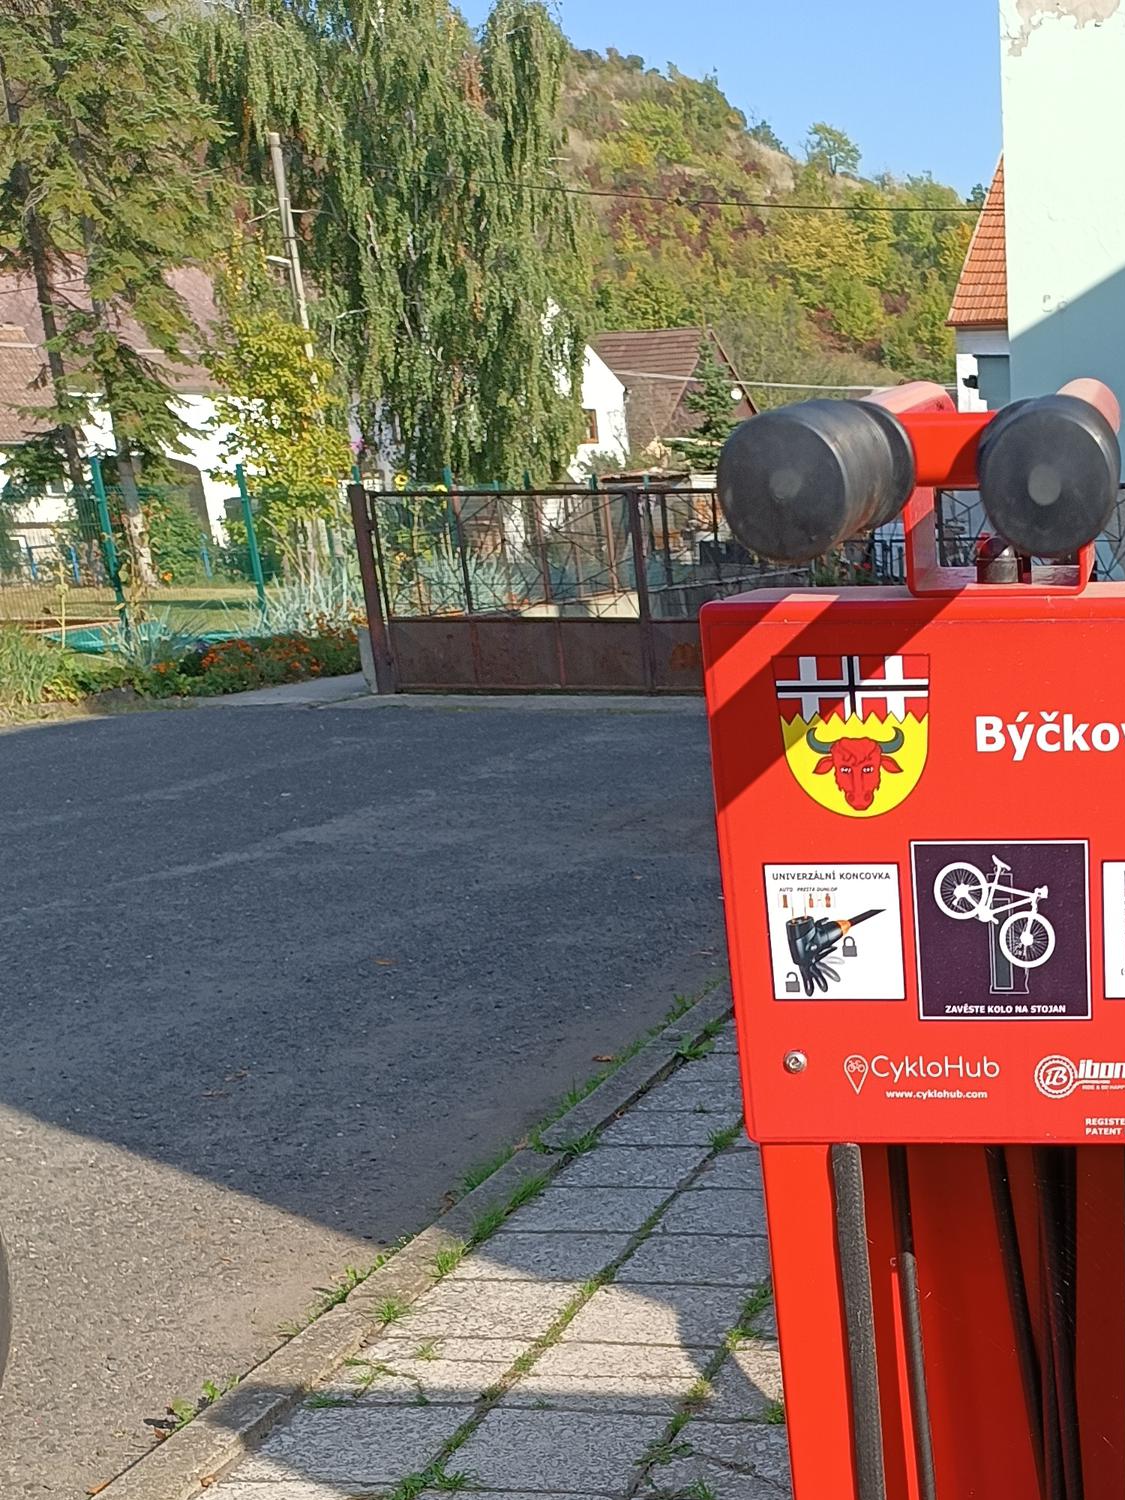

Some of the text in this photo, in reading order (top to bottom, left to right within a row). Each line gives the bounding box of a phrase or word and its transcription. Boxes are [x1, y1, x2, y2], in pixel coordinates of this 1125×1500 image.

[772, 870, 890, 880] UNIVERZÁLNÍ KONCOVKA
[945, 1004, 985, 1013] ZAVĚSTE
[871, 1055, 1000, 1083] CykloHub
[886, 1090, 987, 1099] www.cyklohub.com
